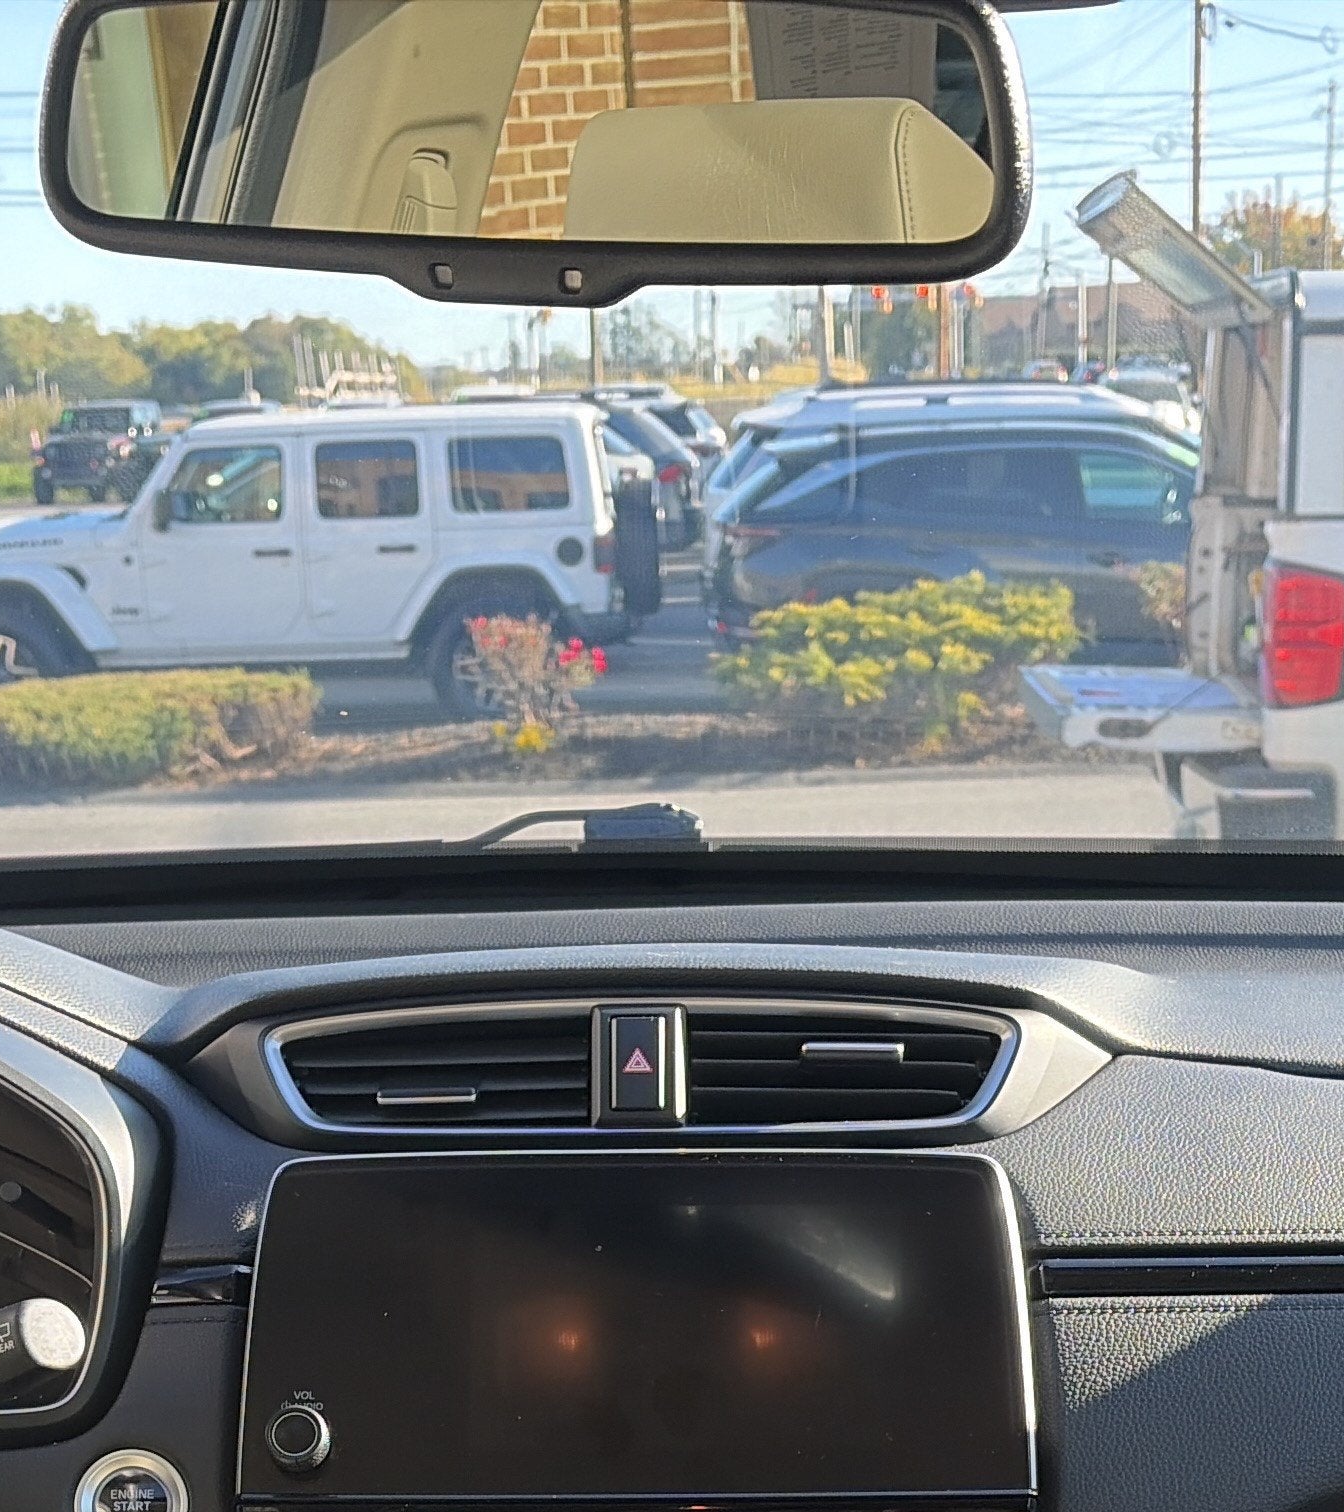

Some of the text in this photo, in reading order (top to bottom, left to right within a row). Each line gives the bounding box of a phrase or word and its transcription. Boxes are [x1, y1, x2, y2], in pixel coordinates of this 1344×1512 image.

[293, 1390, 315, 1400] VOL
[110, 1489, 155, 1500] ENGINE
[113, 1500, 152, 1511] START
